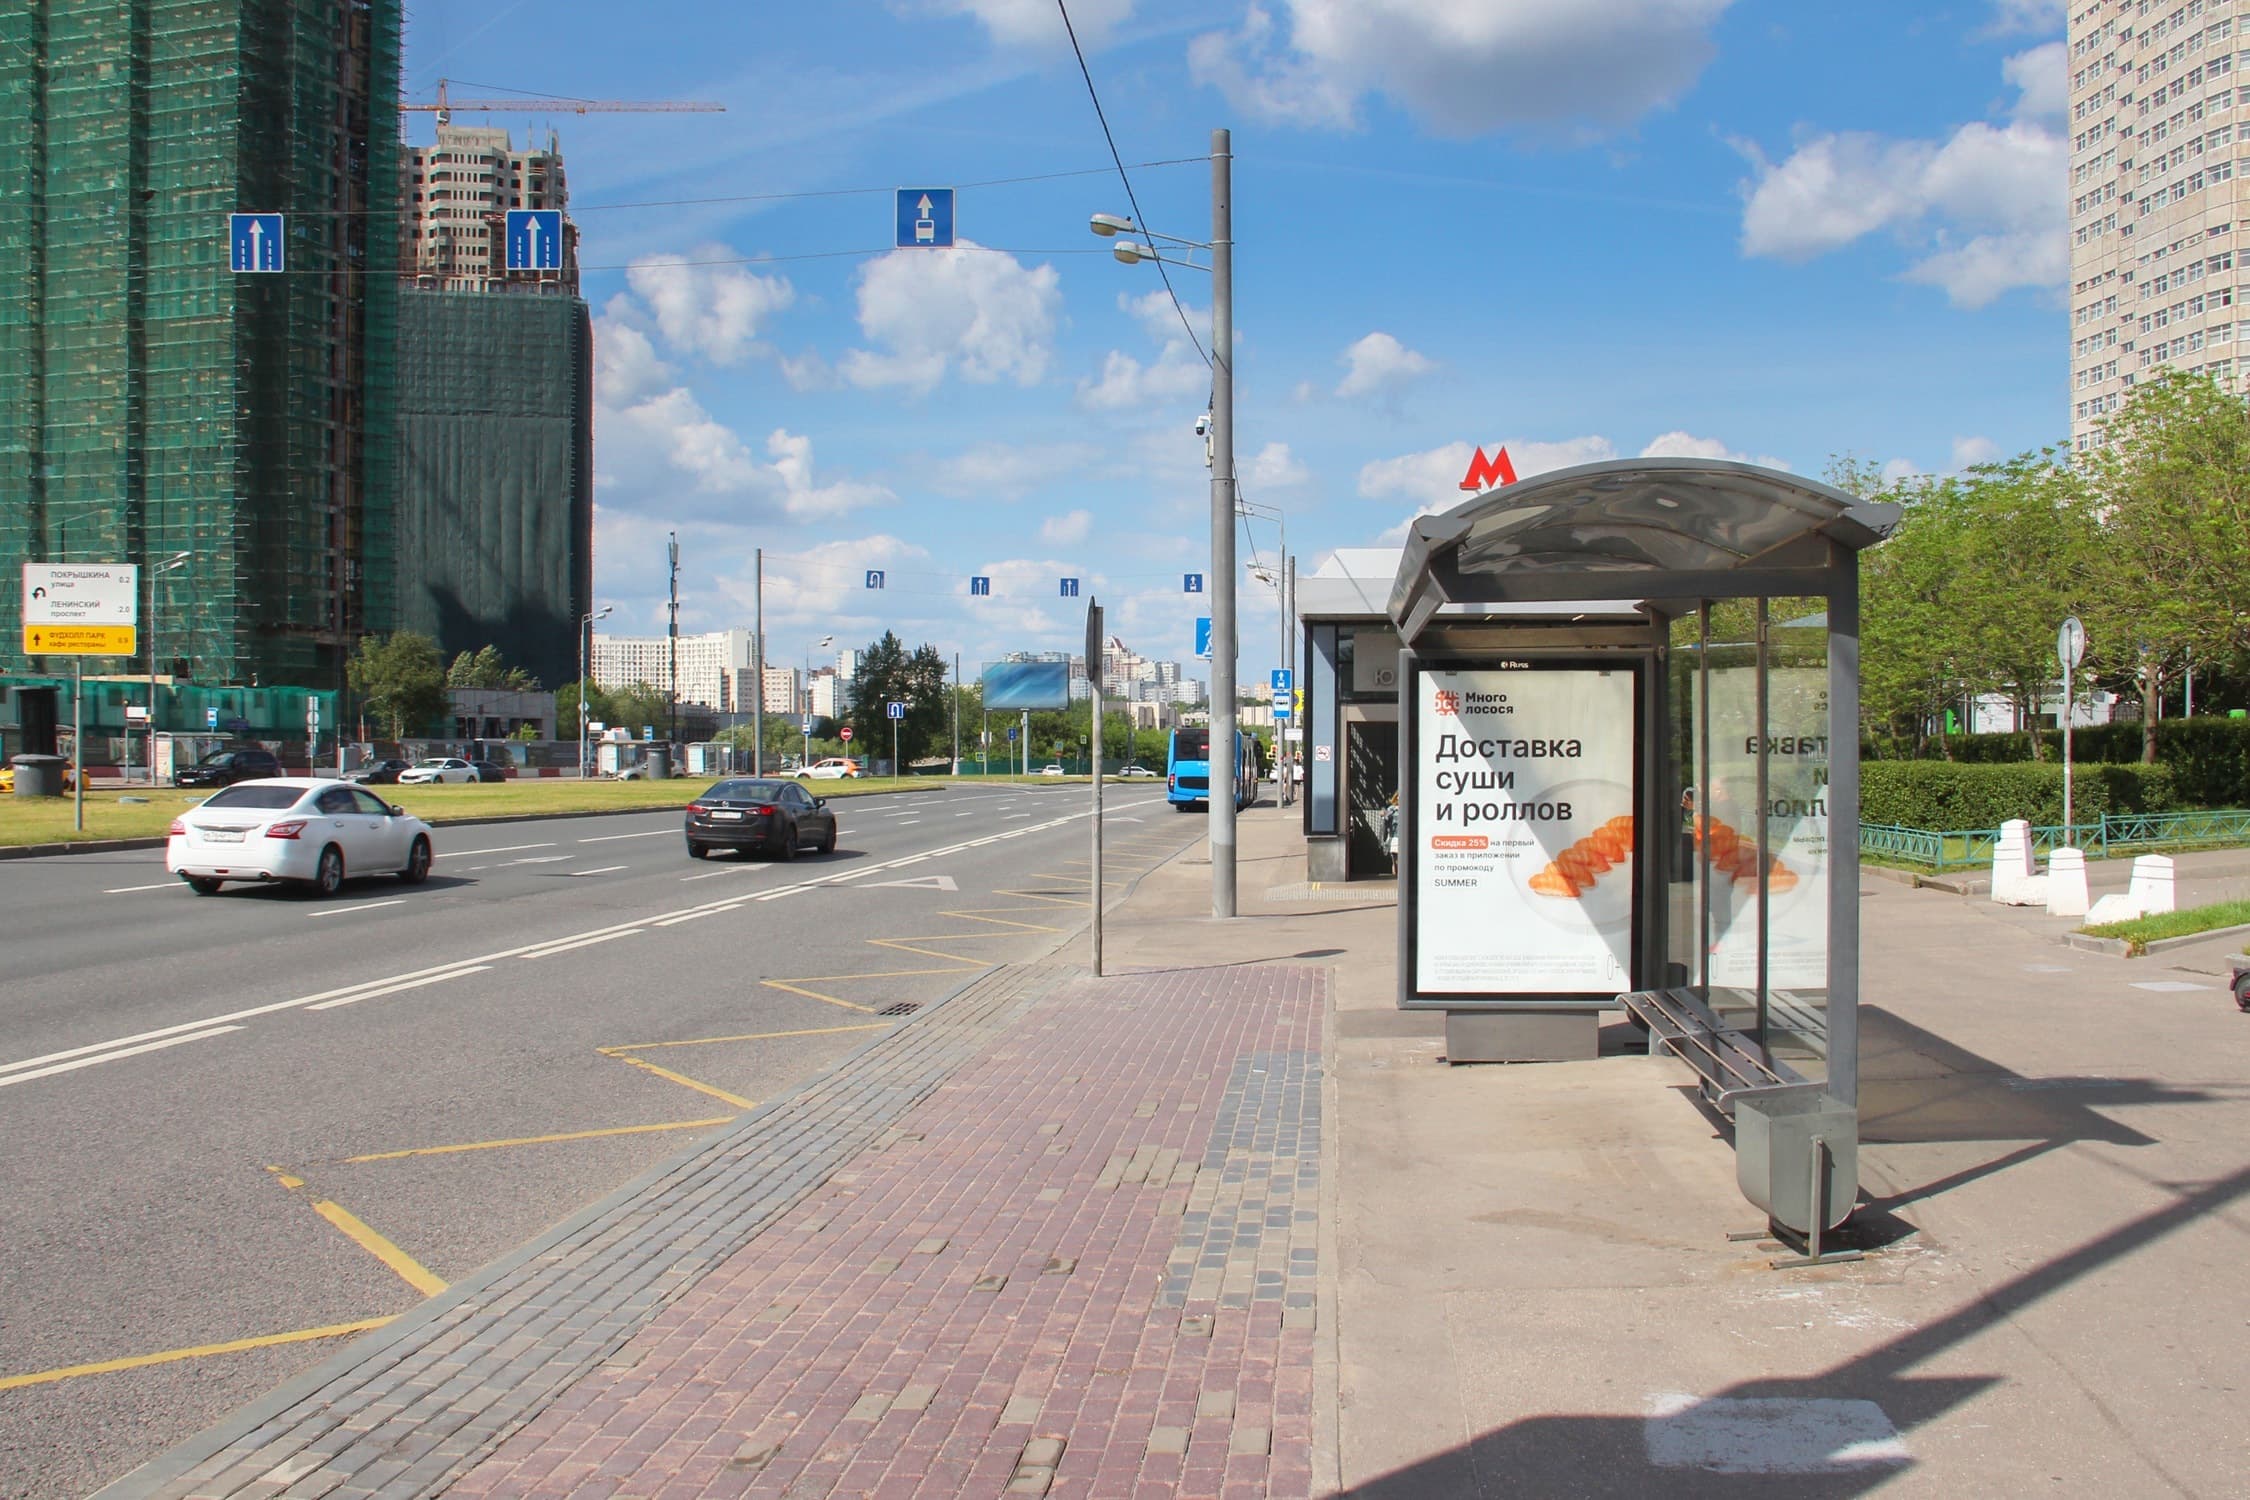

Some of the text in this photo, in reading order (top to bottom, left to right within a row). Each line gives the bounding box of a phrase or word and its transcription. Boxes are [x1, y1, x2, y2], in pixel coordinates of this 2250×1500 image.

[50, 571, 110, 579] ПОКРЫШКИНА
[50, 600, 100, 608] ЛЕНИНСКИЙ
[86, 632, 106, 640] ПАРК
[1465, 692, 1507, 702] Много
[1465, 705, 1514, 714] лосося
[1435, 734, 1581, 763] Доставка
[1436, 771, 1514, 795] суши
[1436, 802, 1572, 826] и роллов
[1434, 839, 1466, 847] Скидка
[1469, 839, 1487, 847] 25%
[1502, 839, 1535, 847] первый
[1467, 852, 1520, 860] приложении
[1434, 879, 1477, 887] SUMMER
